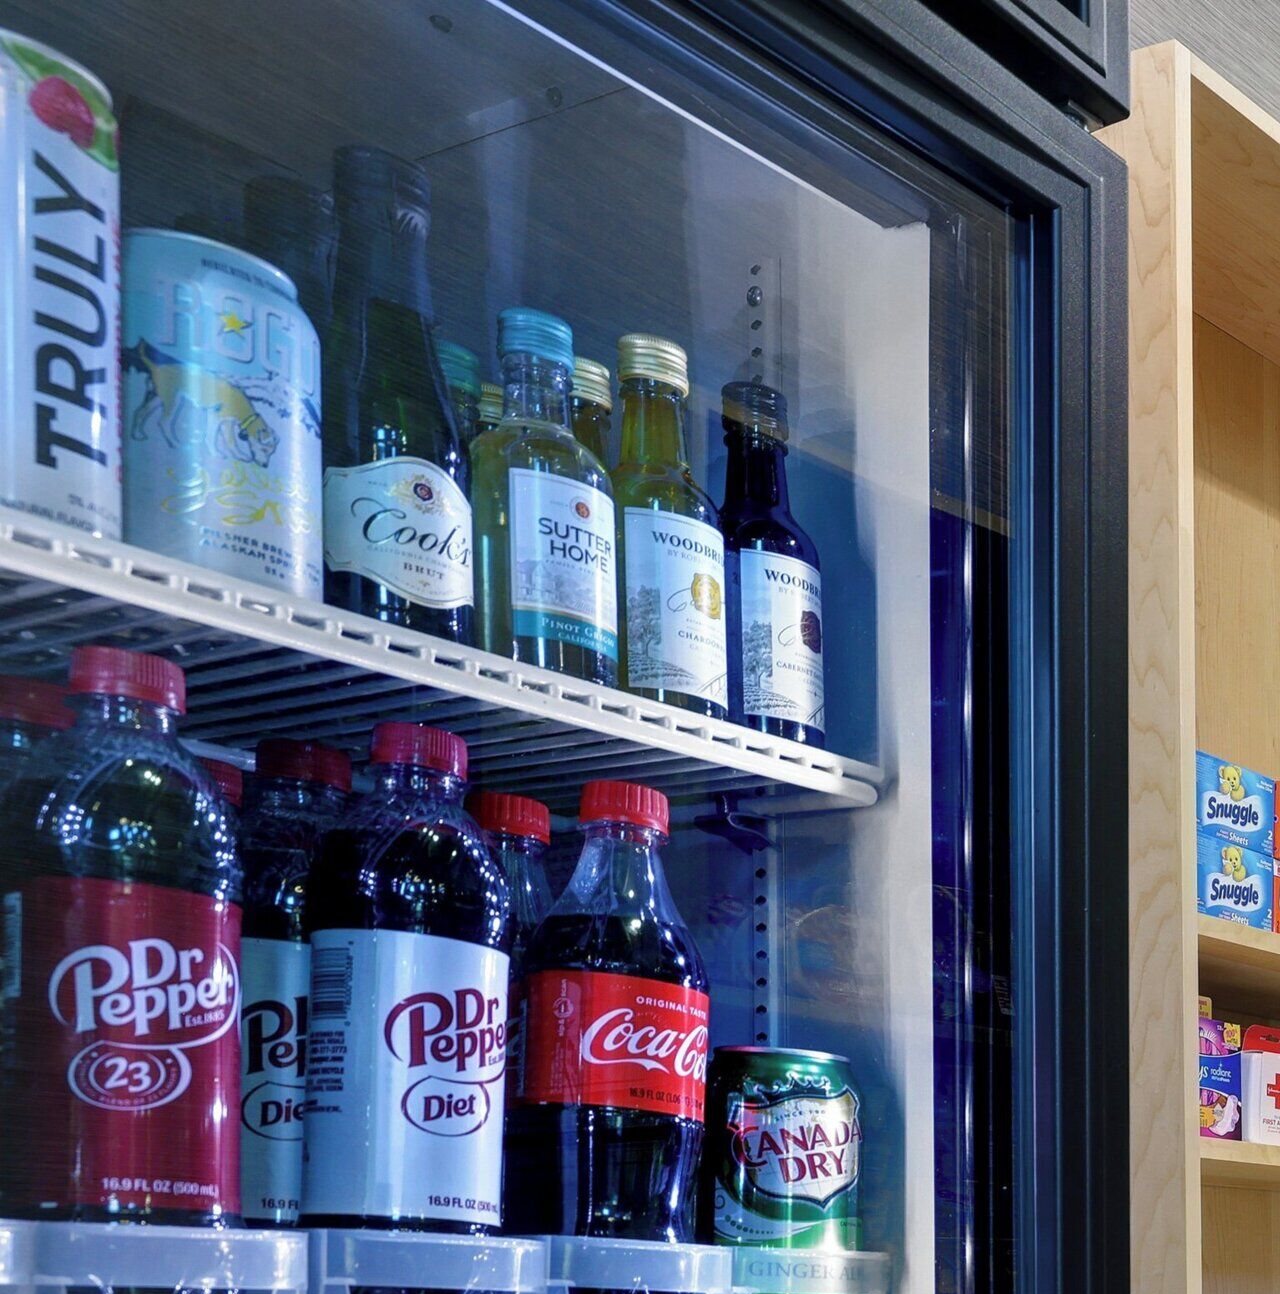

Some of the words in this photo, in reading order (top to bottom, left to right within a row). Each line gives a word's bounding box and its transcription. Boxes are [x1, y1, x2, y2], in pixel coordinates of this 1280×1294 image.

[33, 150, 106, 468] TRULY
[351, 497, 471, 568] Cook's
[538, 517, 612, 559] SUTTER
[402, 562, 446, 580] BRUT
[550, 540, 608, 573] HOME
[541, 616, 580, 634] PINOT
[1207, 796, 1259, 826] Snuggle
[1229, 832, 1248, 845] Sheets
[1210, 878, 1259, 907] Snuggle
[1231, 912, 1249, 926] Sheets
[128, 938, 204, 990] Dr
[49, 944, 239, 1036] Pepper
[454, 988, 499, 1031] Dr
[636, 996, 687, 1013] ORIGINAL
[690, 1007, 706, 1020] TASTE
[384, 992, 505, 1072] Peppe
[580, 1008, 708, 1085] Coca-Co
[103, 1056, 151, 1093] 23
[1211, 1067, 1232, 1078] radiant
[423, 1093, 476, 1122] Diet
[1263, 1118, 1276, 1126] FIRST
[727, 1117, 862, 1170] CANADA
[778, 1149, 848, 1184] DRY
[101, 1177, 132, 1190] 16.9
[134, 1179, 151, 1191] FL
[153, 1181, 171, 1193] OZ
[427, 1195, 450, 1206] 16.9
[451, 1197, 464, 1207] FL
[466, 1199, 476, 1209] OZ
[748, 1261, 835, 1280] GINGER
